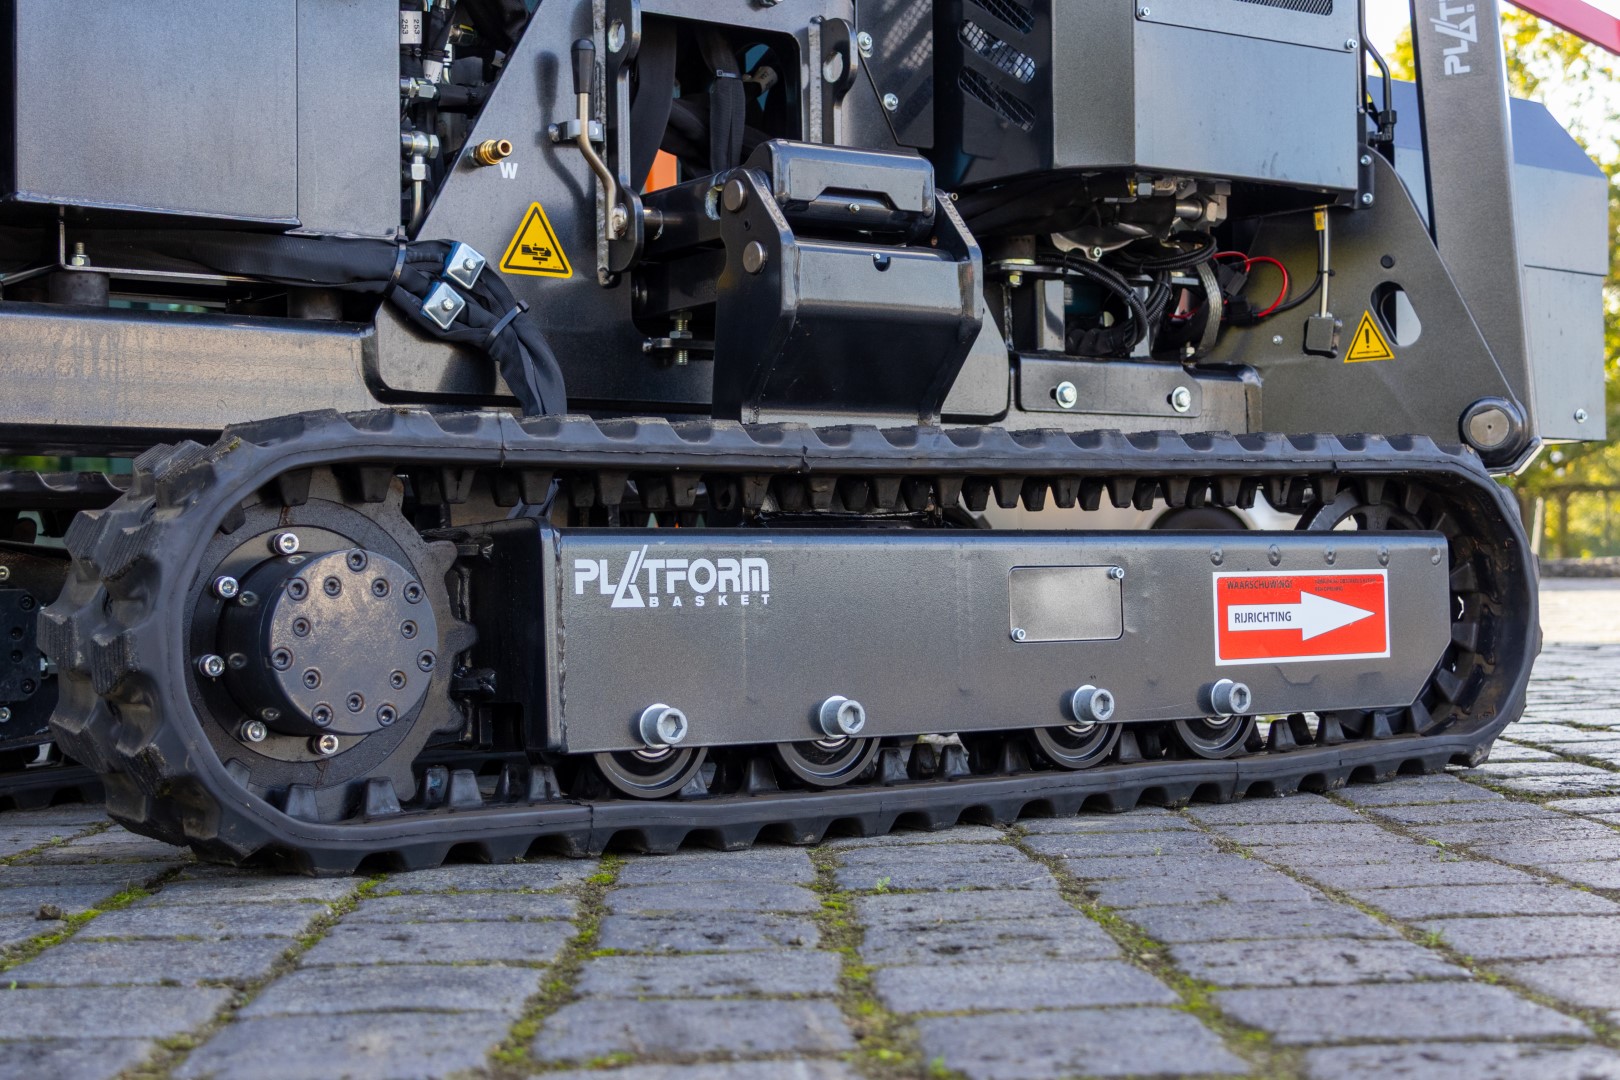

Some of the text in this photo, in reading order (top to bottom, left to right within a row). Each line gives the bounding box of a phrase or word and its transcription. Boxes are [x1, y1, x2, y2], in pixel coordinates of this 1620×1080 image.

[1429, 0, 1478, 76] PLAT
[500, 161, 518, 179] W
[574, 544, 770, 608] PLATFORM
[649, 593, 770, 608] BASKET
[1234, 611, 1292, 624] RIJRICHTING
